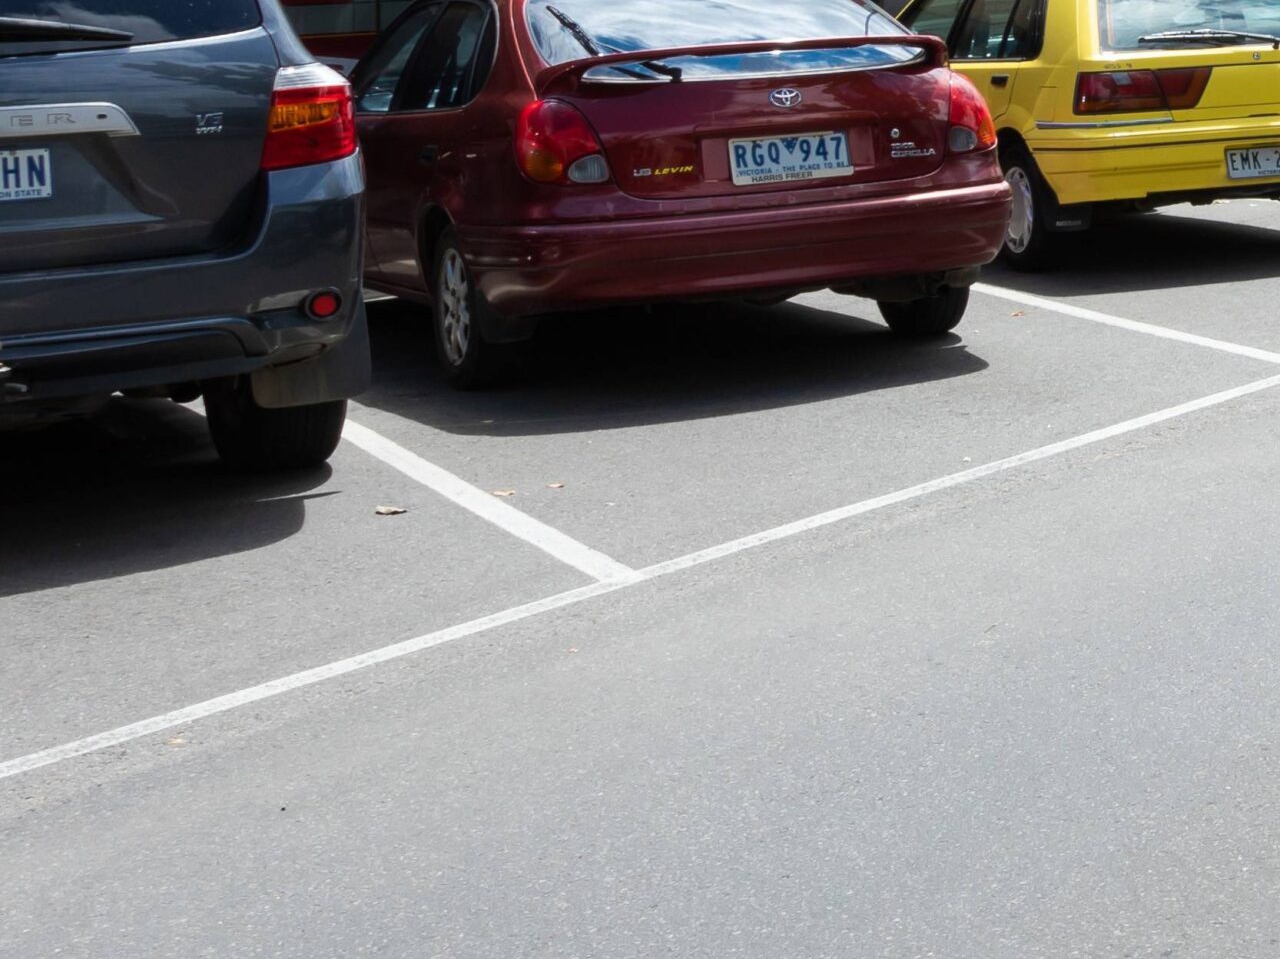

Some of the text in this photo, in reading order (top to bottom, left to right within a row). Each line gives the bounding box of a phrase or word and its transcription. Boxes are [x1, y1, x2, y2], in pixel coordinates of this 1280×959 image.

[734, 136, 843, 168] RGQ 947
[890, 148, 936, 158] COROLLA
[654, 165, 694, 176] LEVIN
[738, 167, 772, 177] VICTORIA
[752, 171, 813, 183] HARRIS FREER
[14, 188, 43, 197] STATE
